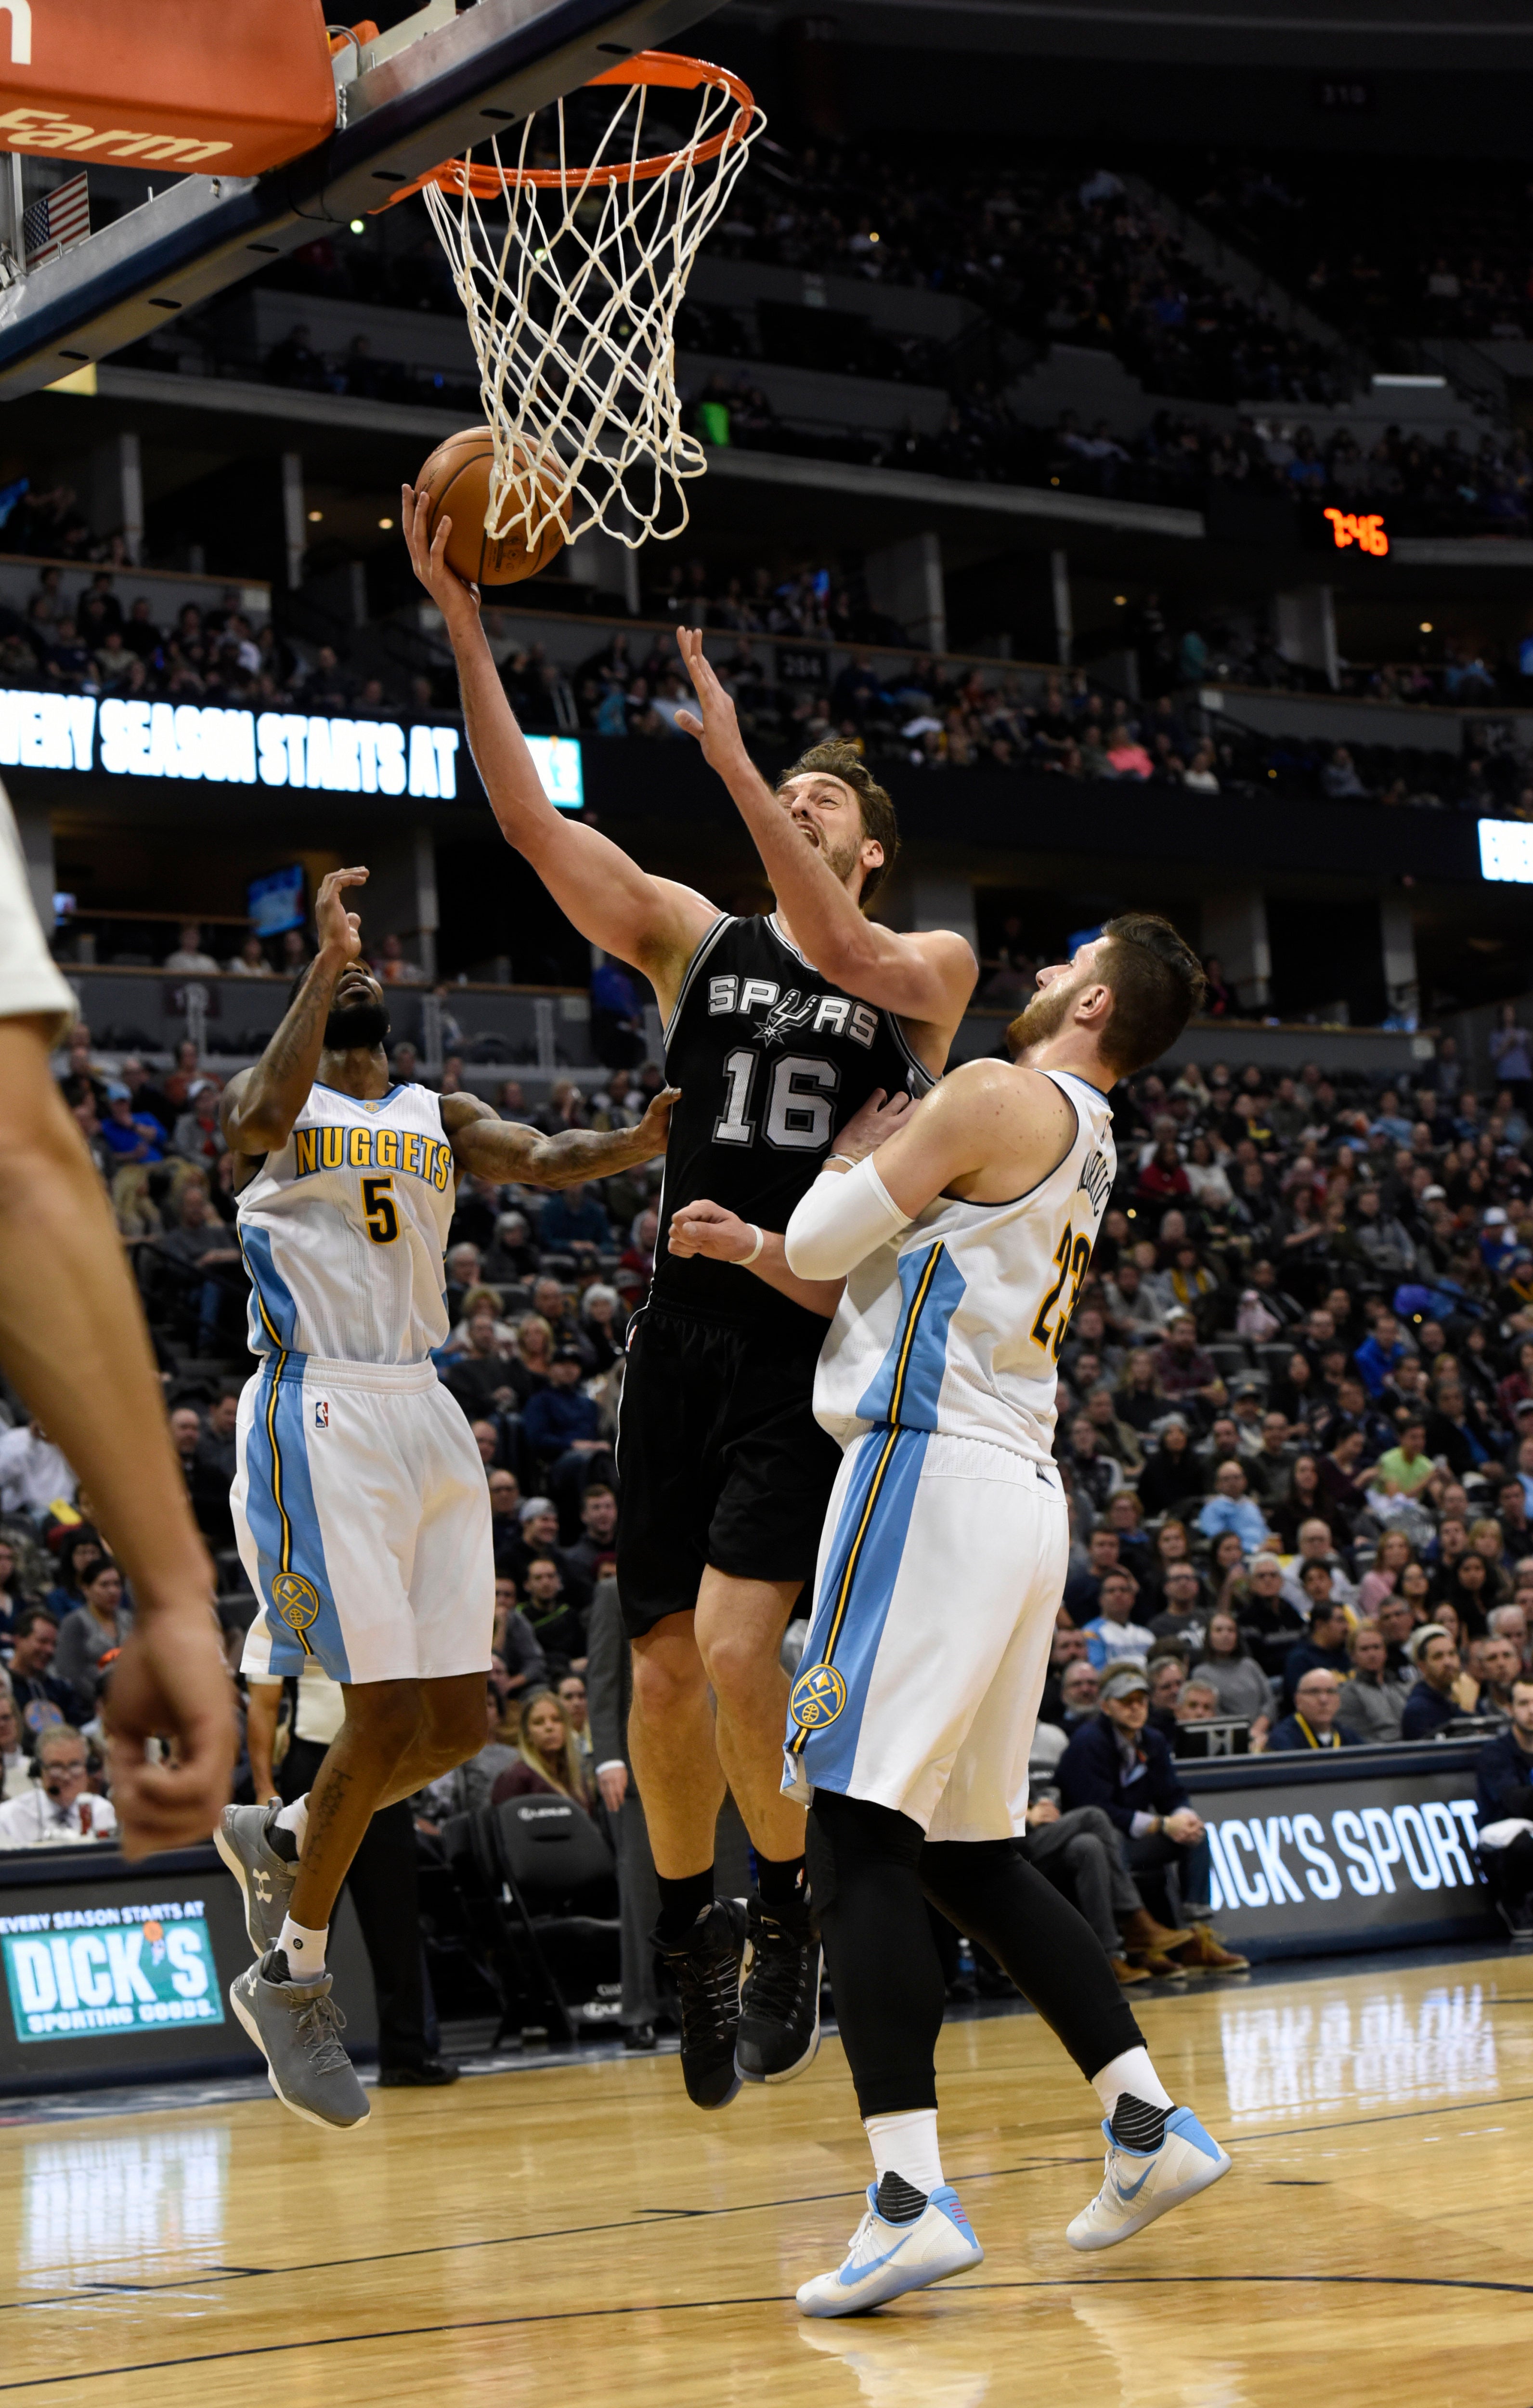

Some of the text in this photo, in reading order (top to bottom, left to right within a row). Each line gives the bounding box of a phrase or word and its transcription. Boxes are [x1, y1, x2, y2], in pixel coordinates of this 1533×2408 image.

[0, 108, 234, 163] Farm
[0, 688, 96, 771] VERY
[99, 698, 256, 783] SEASON
[258, 712, 406, 795] STARTS
[409, 725, 458, 799] AT
[708, 974, 879, 1050] SPURS
[711, 1046, 842, 1153] 16
[292, 1125, 452, 1193] NUGGETS
[360, 1175, 400, 1245] 5
[0, 1900, 205, 1935] EVERY SEASON STARTS AT
[12, 1926, 210, 2014] DICK'S
[27, 2006, 135, 2033] SPORTING
